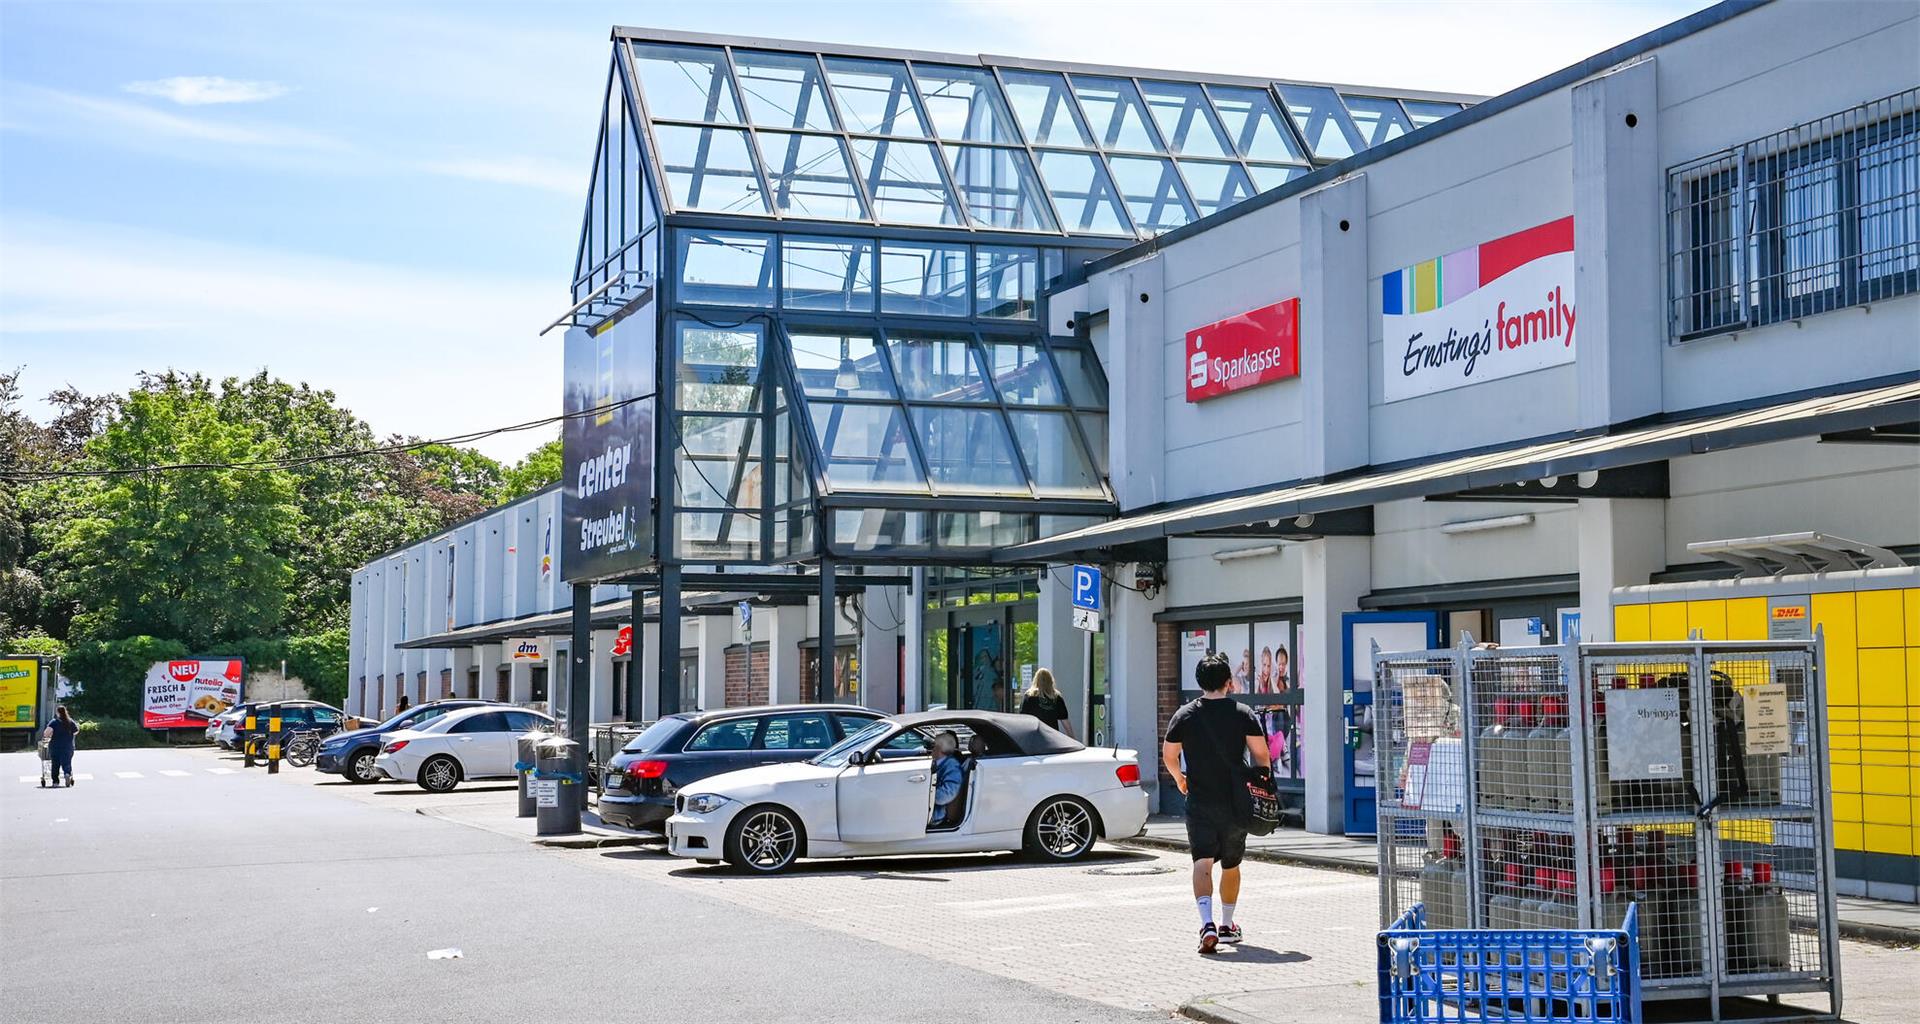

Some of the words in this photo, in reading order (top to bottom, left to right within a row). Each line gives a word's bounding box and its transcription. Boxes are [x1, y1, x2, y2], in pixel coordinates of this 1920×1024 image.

[1403, 319, 1491, 377] Ernsting's
[1496, 286, 1576, 351] family
[1214, 346, 1281, 388] Sparkasse
[578, 443, 631, 499] center
[580, 506, 626, 551] Streubel
[1077, 571, 1092, 601] P
[518, 641, 538, 653] dm
[171, 664, 198, 677] NEU
[147, 684, 179, 695] FRISCH
[180, 684, 186, 692] &
[195, 678, 224, 687] nutella
[151, 695, 176, 704] WARM
